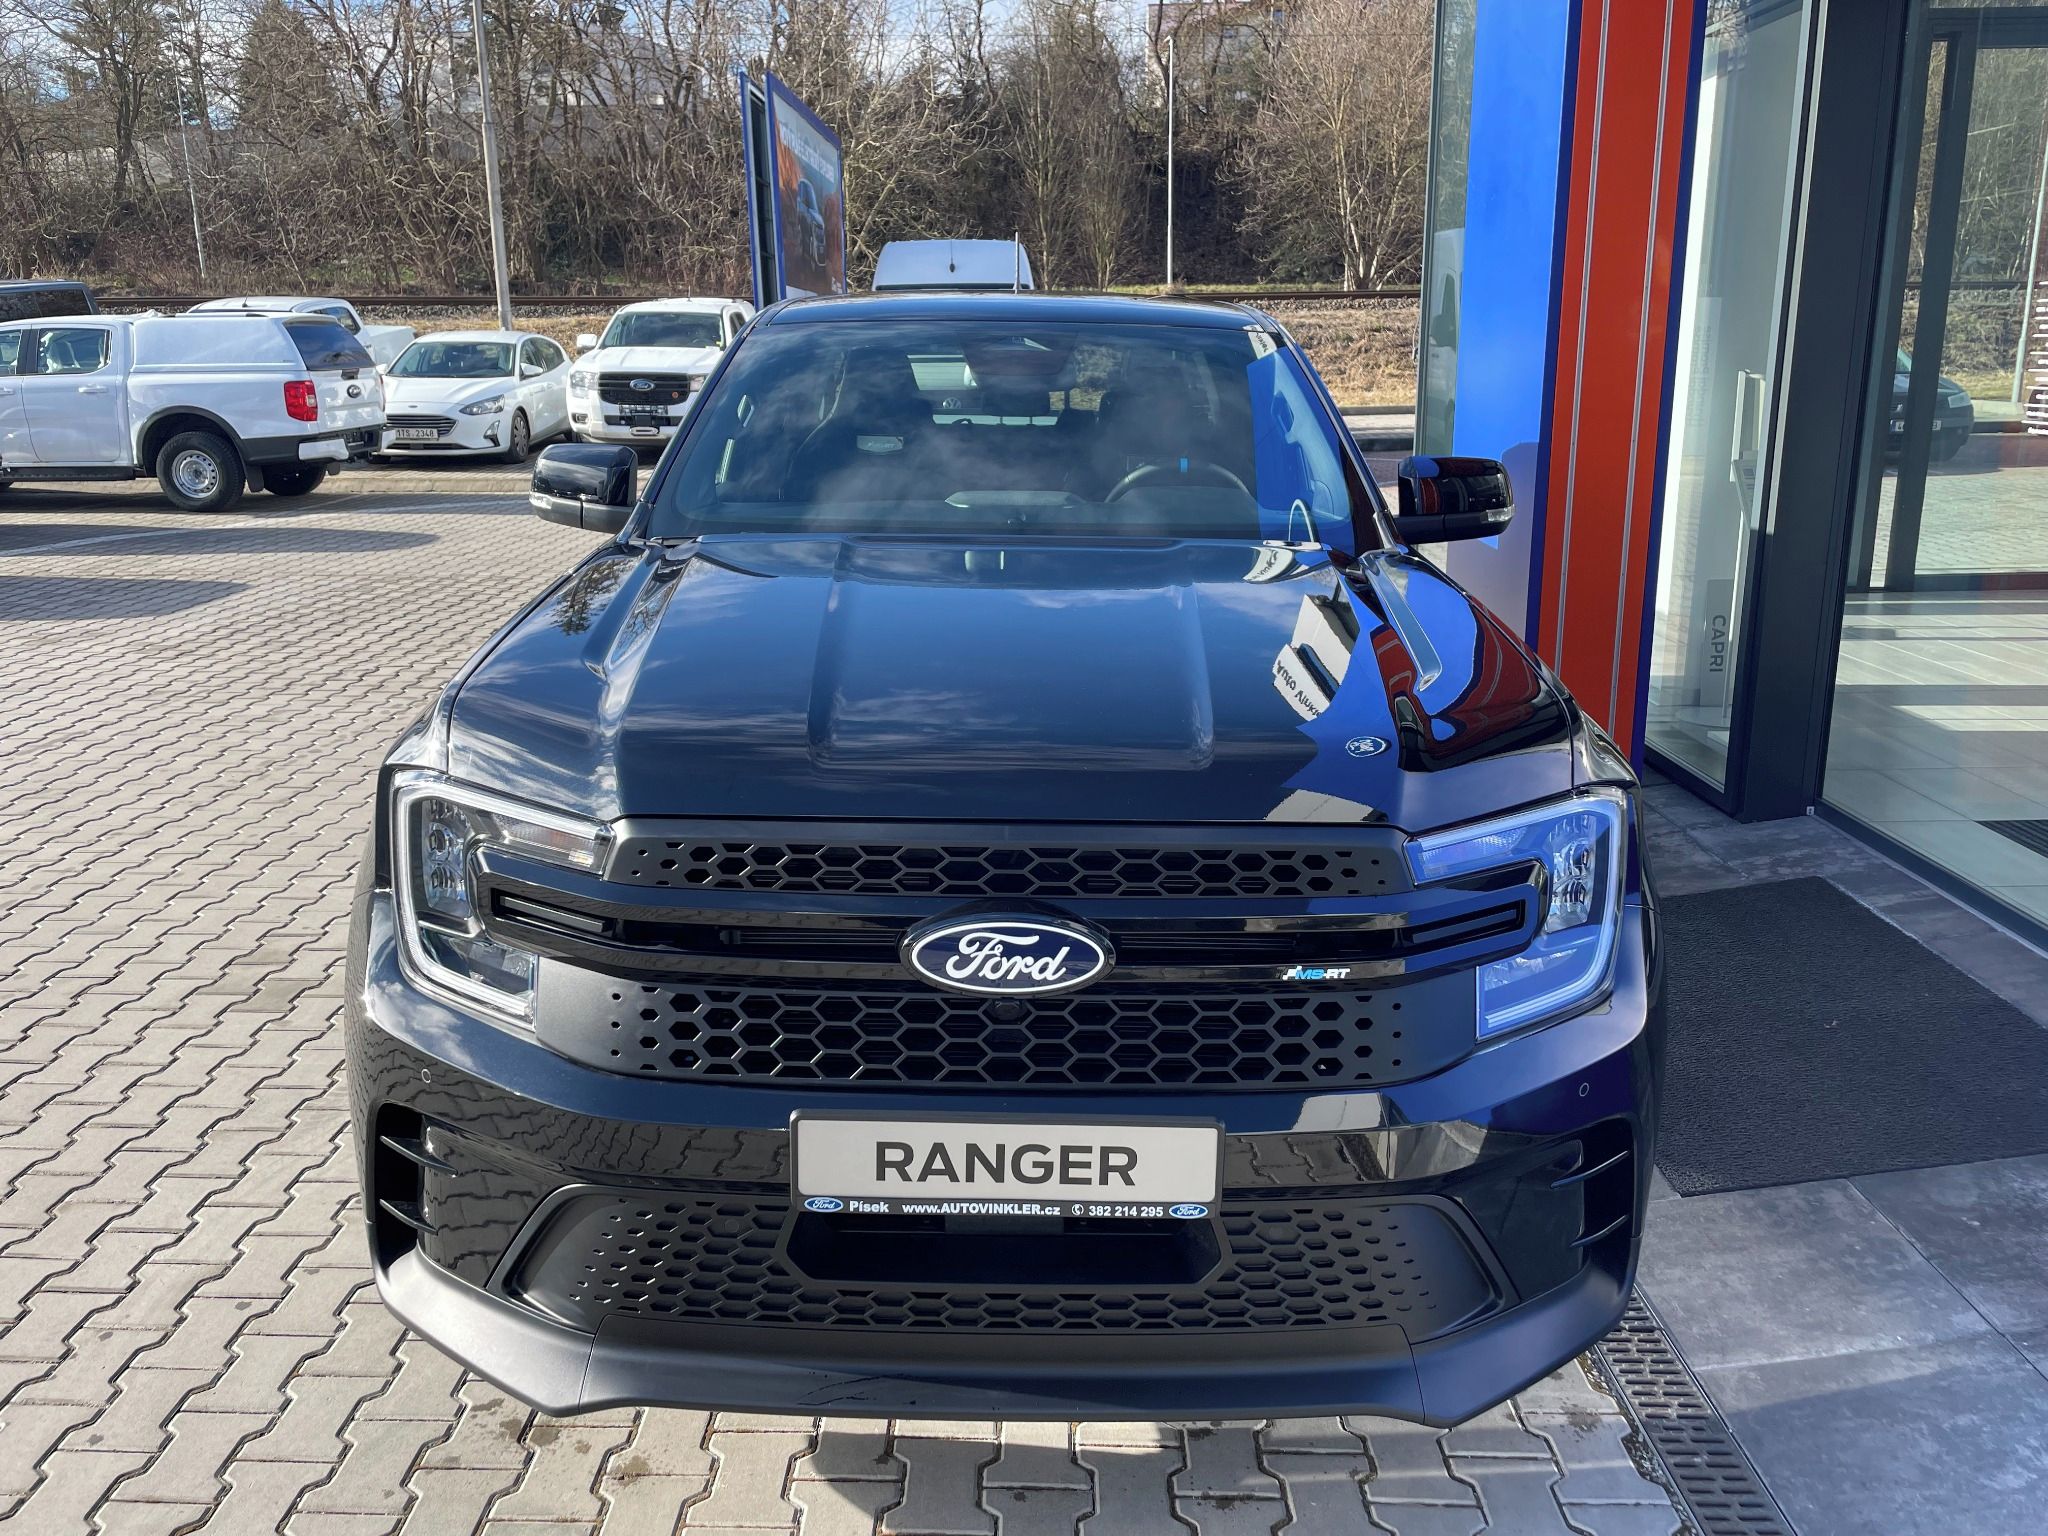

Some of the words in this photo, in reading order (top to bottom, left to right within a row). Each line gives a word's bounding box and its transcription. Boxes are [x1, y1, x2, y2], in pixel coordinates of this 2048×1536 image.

[1709, 615, 1727, 673] CAPRI
[945, 932, 1071, 981] Ford
[875, 1141, 1138, 1186] RANGER
[812, 1199, 836, 1210] Ford
[849, 1200, 890, 1213] Písek
[902, 1203, 1061, 1216] www.AUTOVINKLER.cz
[1088, 1205, 1112, 1217] 382
[1114, 1206, 1138, 1217] 214
[1140, 1206, 1164, 1217] 295
[1176, 1206, 1200, 1216] Ford
